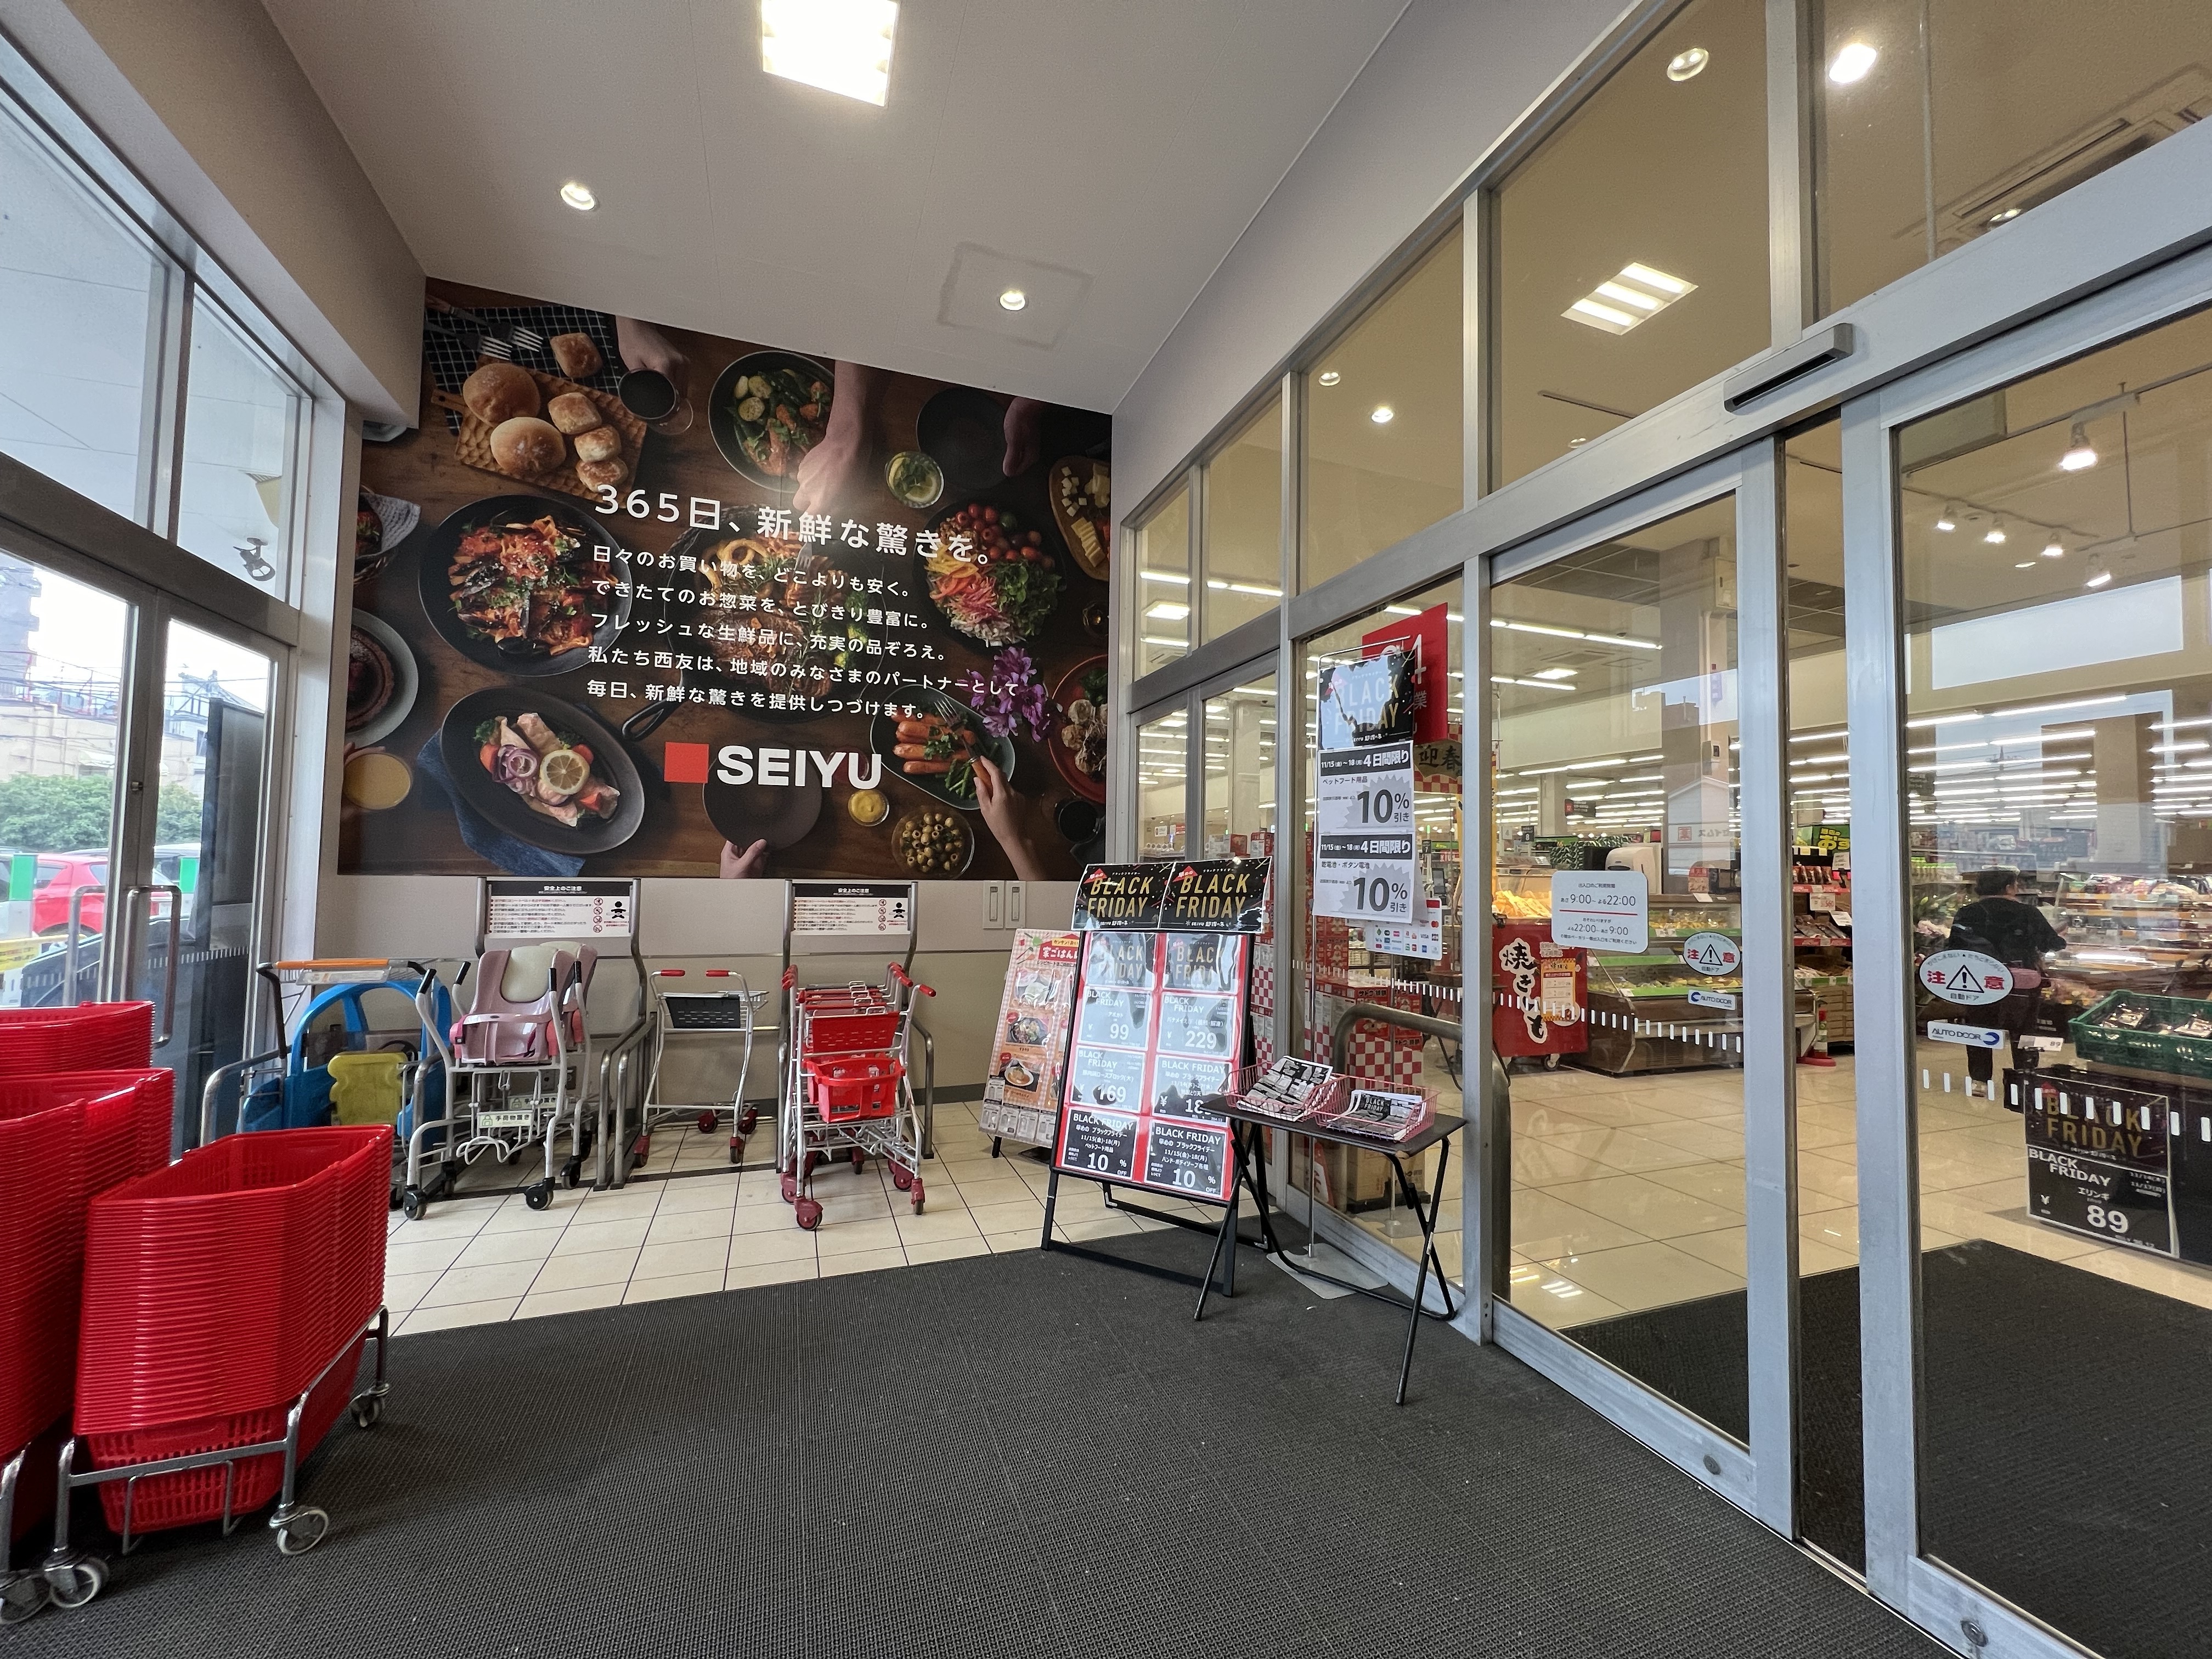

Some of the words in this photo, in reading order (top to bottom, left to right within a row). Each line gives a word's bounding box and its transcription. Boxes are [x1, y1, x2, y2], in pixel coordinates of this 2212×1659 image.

[595, 484, 988, 565] 365日、新鮮な驚きを。
[594, 545, 908, 597] 日々のお買い物を、どこよりも安く。
[592, 580, 927, 629] できたてのお惣菜を、とびきり豊富に。
[591, 613, 944, 661] フレッシュな生鮮品に、充実の品ぞろえ。
[588, 646, 1019, 696] 私たち西友は、地域のみなさまのパートナーとして
[587, 680, 923, 719] 毎日、新鮮な驚きを提供しつづけます。
[716, 745, 882, 789] SEIYU
[1322, 776, 1368, 786] ペットフード用品
[1357, 789, 1393, 823] 10
[1393, 812, 1410, 823] 引き
[1090, 876, 1154, 895] BLACK
[1180, 873, 1250, 894] BLACK
[1353, 877, 1390, 912] 10
[1087, 897, 1148, 918] FRIDAY
[1175, 896, 1246, 918] FRIDAY
[1390, 902, 1407, 913] 引き
[1177, 945, 1224, 962] BLAC
[1096, 998, 1124, 1007] FRIDAY
[1164, 996, 1189, 1005] BLACK
[1174, 1005, 1204, 1014] FRIDAY
[1110, 1023, 1129, 1040] 99
[1185, 1030, 1217, 1049] 229
[1079, 1049, 1103, 1059] BLACK
[1088, 1058, 1118, 1069] FRIDAY
[1161, 1060, 1189, 1070] BLACK
[1192, 1063, 1225, 1074] FRIDAY
[1098, 1084, 1126, 1103] 169
[1160, 1095, 1168, 1107] ¥
[1185, 1098, 1211, 1115] 18
[1364, 1104, 1384, 1112] FRIDAY
[1073, 1113, 1099, 1125] BLACK
[1101, 1118, 1133, 1131] FRIDAY
[1155, 1126, 1184, 1139] BLACK
[1186, 1131, 1221, 1145] FRIDAY
[2047, 1118, 2142, 1158] FRIDAY
[1087, 1152, 1109, 1171] 10
[1119, 1159, 1127, 1167] %
[2029, 1148, 2078, 1169] BLACK
[1172, 1168, 1196, 1188] 10
[1207, 1175, 1216, 1184] %
[2049, 1162, 2111, 1187] FRIDAY
[2078, 1187, 2110, 1201] エリンギ
[2087, 1205, 2129, 1234] 89
